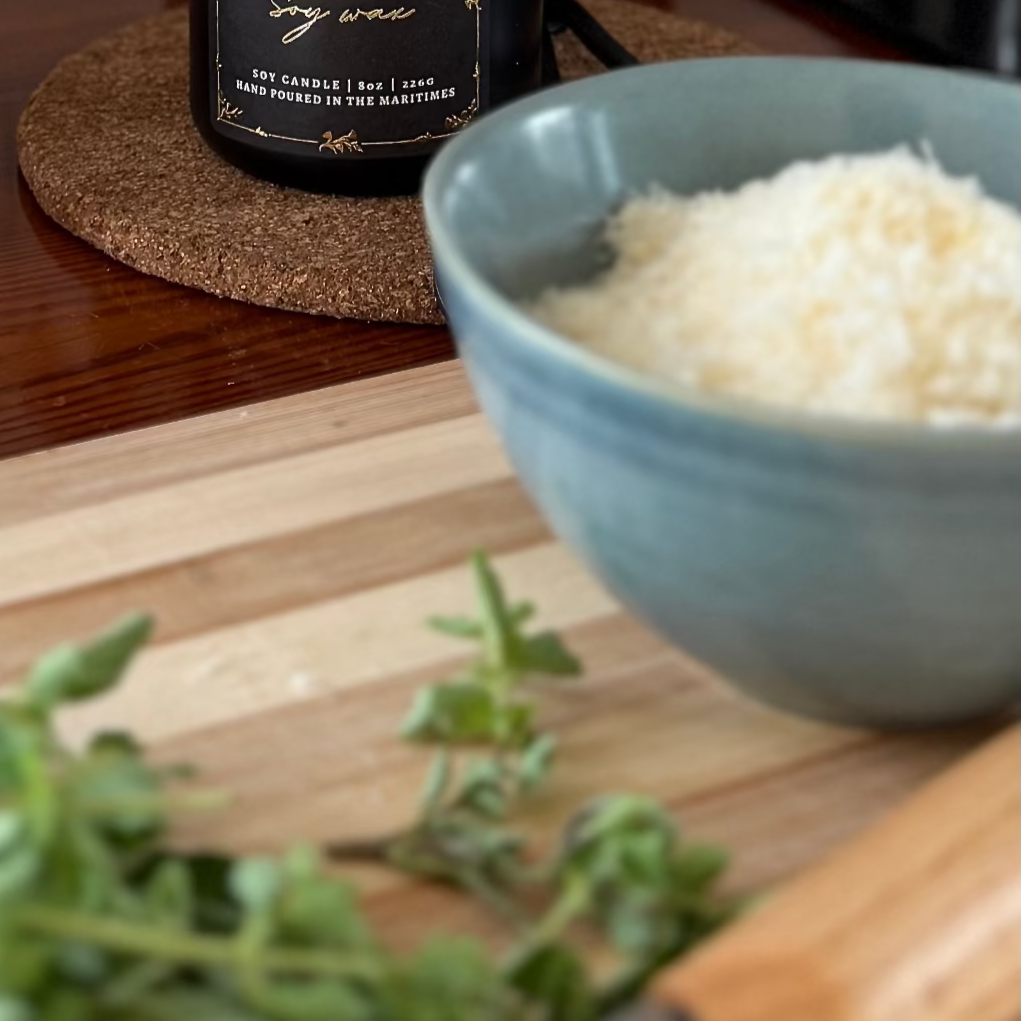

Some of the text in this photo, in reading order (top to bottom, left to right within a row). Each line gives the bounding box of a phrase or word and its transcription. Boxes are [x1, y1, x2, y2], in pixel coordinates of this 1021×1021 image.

[339, 6, 416, 24] wax
[252, 69, 276, 82] SOY
[281, 74, 341, 90] CANDLE
[236, 79, 456, 106] HAND POURED IN THE MARITIMES
